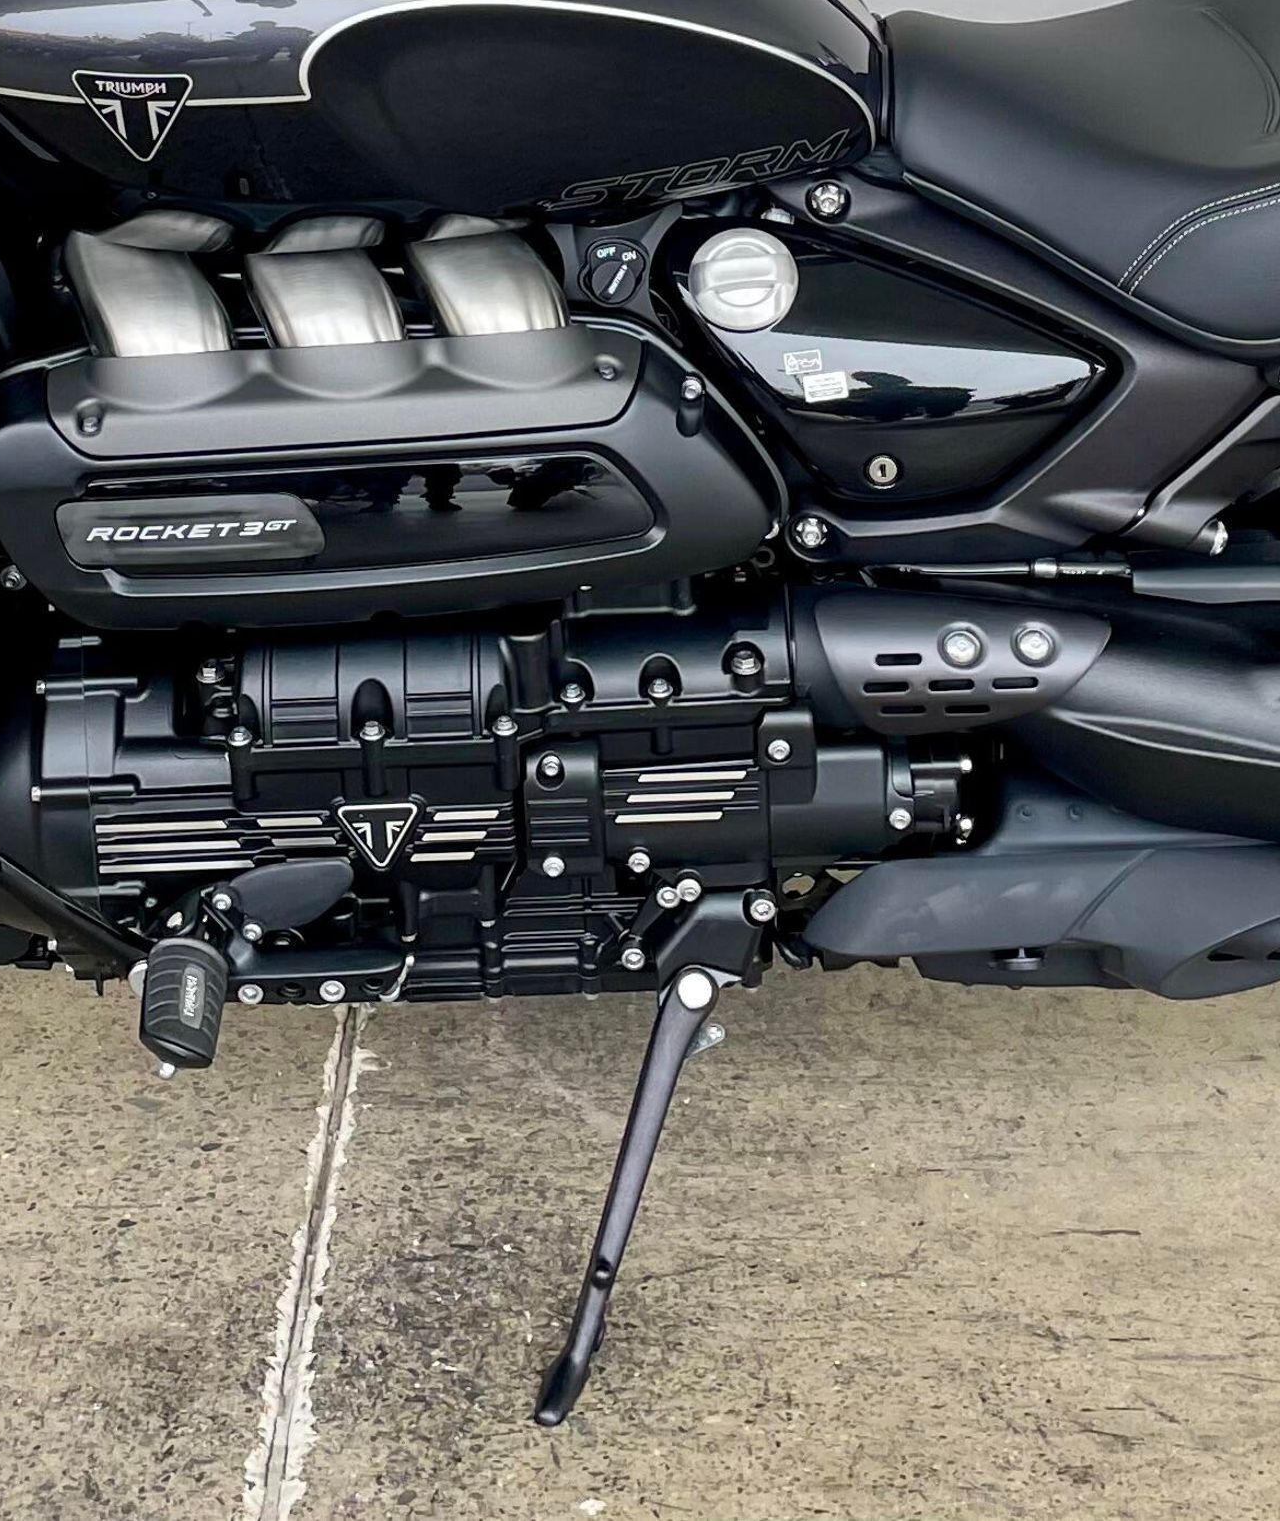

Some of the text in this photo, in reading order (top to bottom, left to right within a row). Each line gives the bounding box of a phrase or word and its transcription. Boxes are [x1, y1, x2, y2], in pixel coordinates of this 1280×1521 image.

[94, 80, 167, 99] TRIUMPH
[544, 128, 851, 212] STORM
[596, 246, 637, 261] OFF ON
[86, 522, 241, 541] ROCKET
